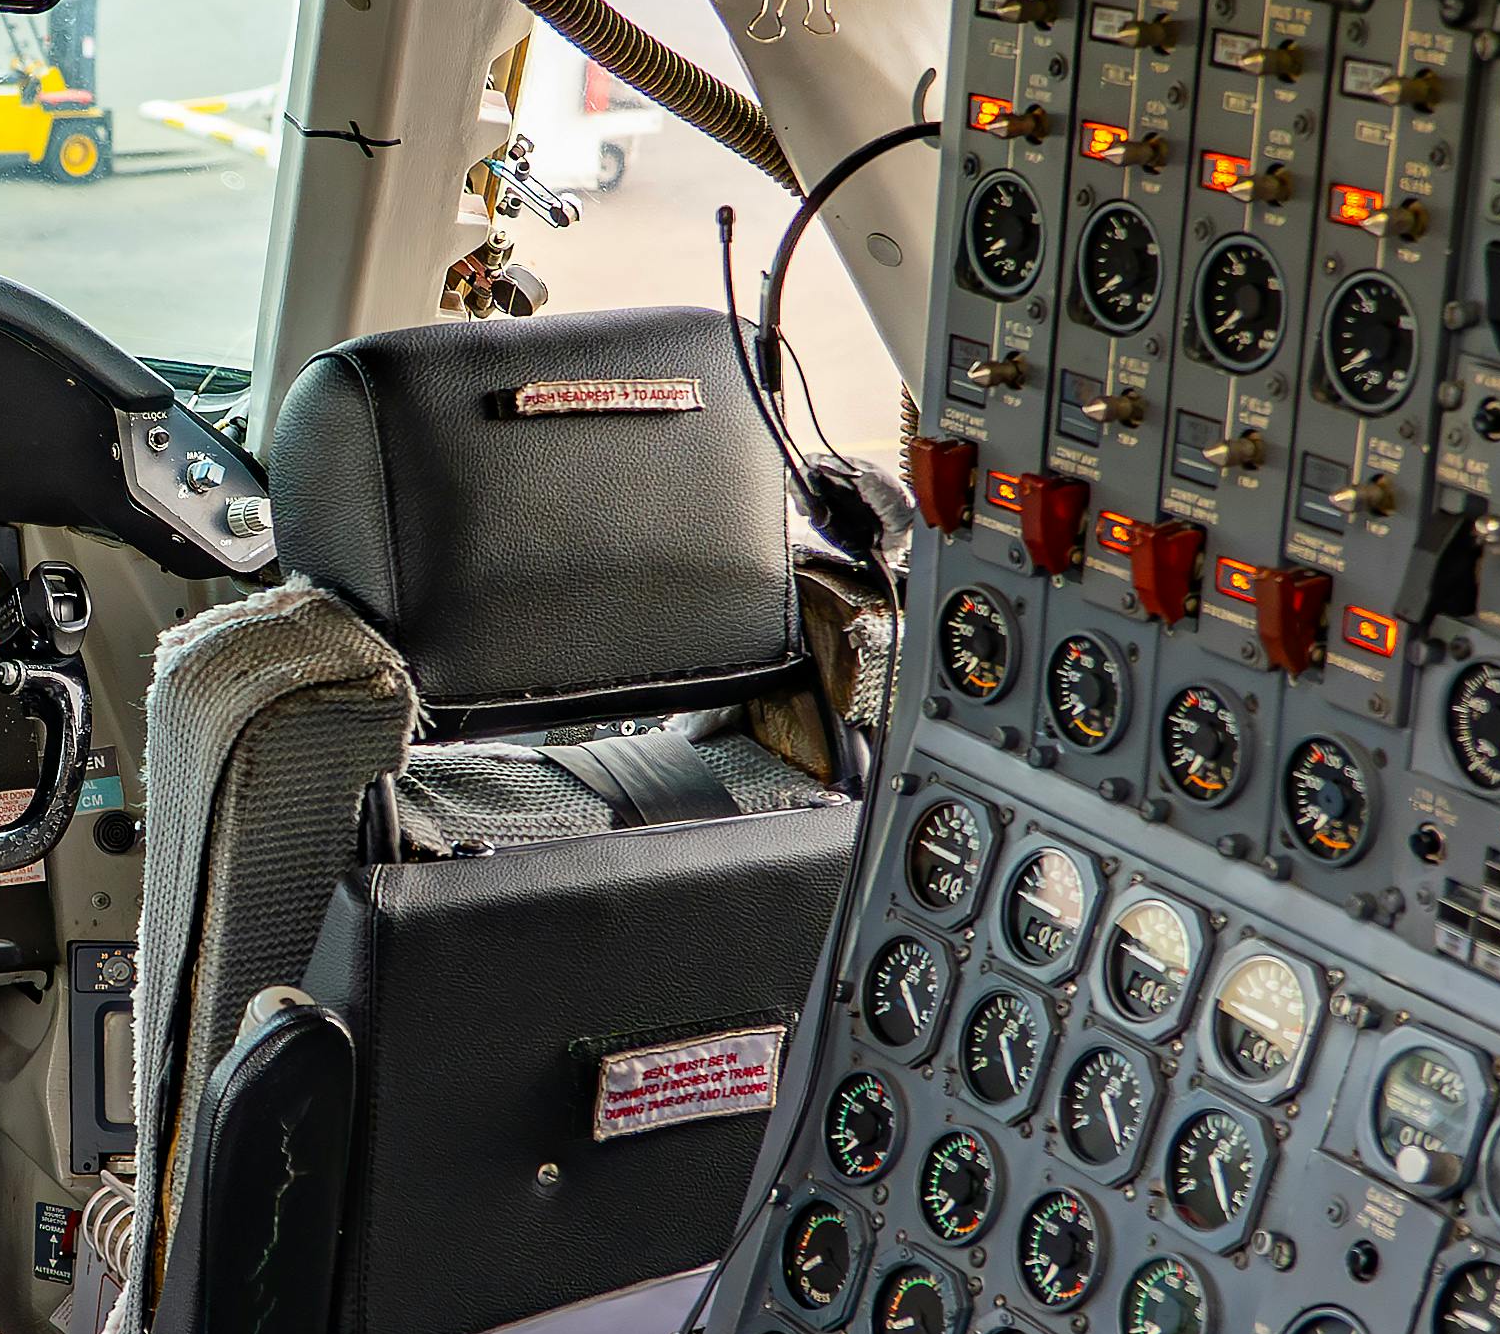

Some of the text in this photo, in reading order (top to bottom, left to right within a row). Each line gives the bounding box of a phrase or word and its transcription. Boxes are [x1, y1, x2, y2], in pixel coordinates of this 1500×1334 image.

[524, 390, 690, 403] PUSH HEADREST TO ADJUST
[944, 407, 986, 428] CONSTANT
[1056, 447, 1100, 469] CONSTANT
[1170, 487, 1216, 509] CONSTANT
[1295, 533, 1344, 555] CONSTANT
[10, 790, 32, 799] DOWN
[644, 1053, 738, 1080] SEAT MUST BE IN
[608, 1084, 660, 1103] FORWARD
[670, 1074, 708, 1089] INCHES
[711, 1071, 727, 1081] OF
[730, 1065, 767, 1079] TRAVEL
[606, 1105, 644, 1119] DURING
[698, 1089, 720, 1101] AND
[722, 1083, 766, 1098] LANDING
